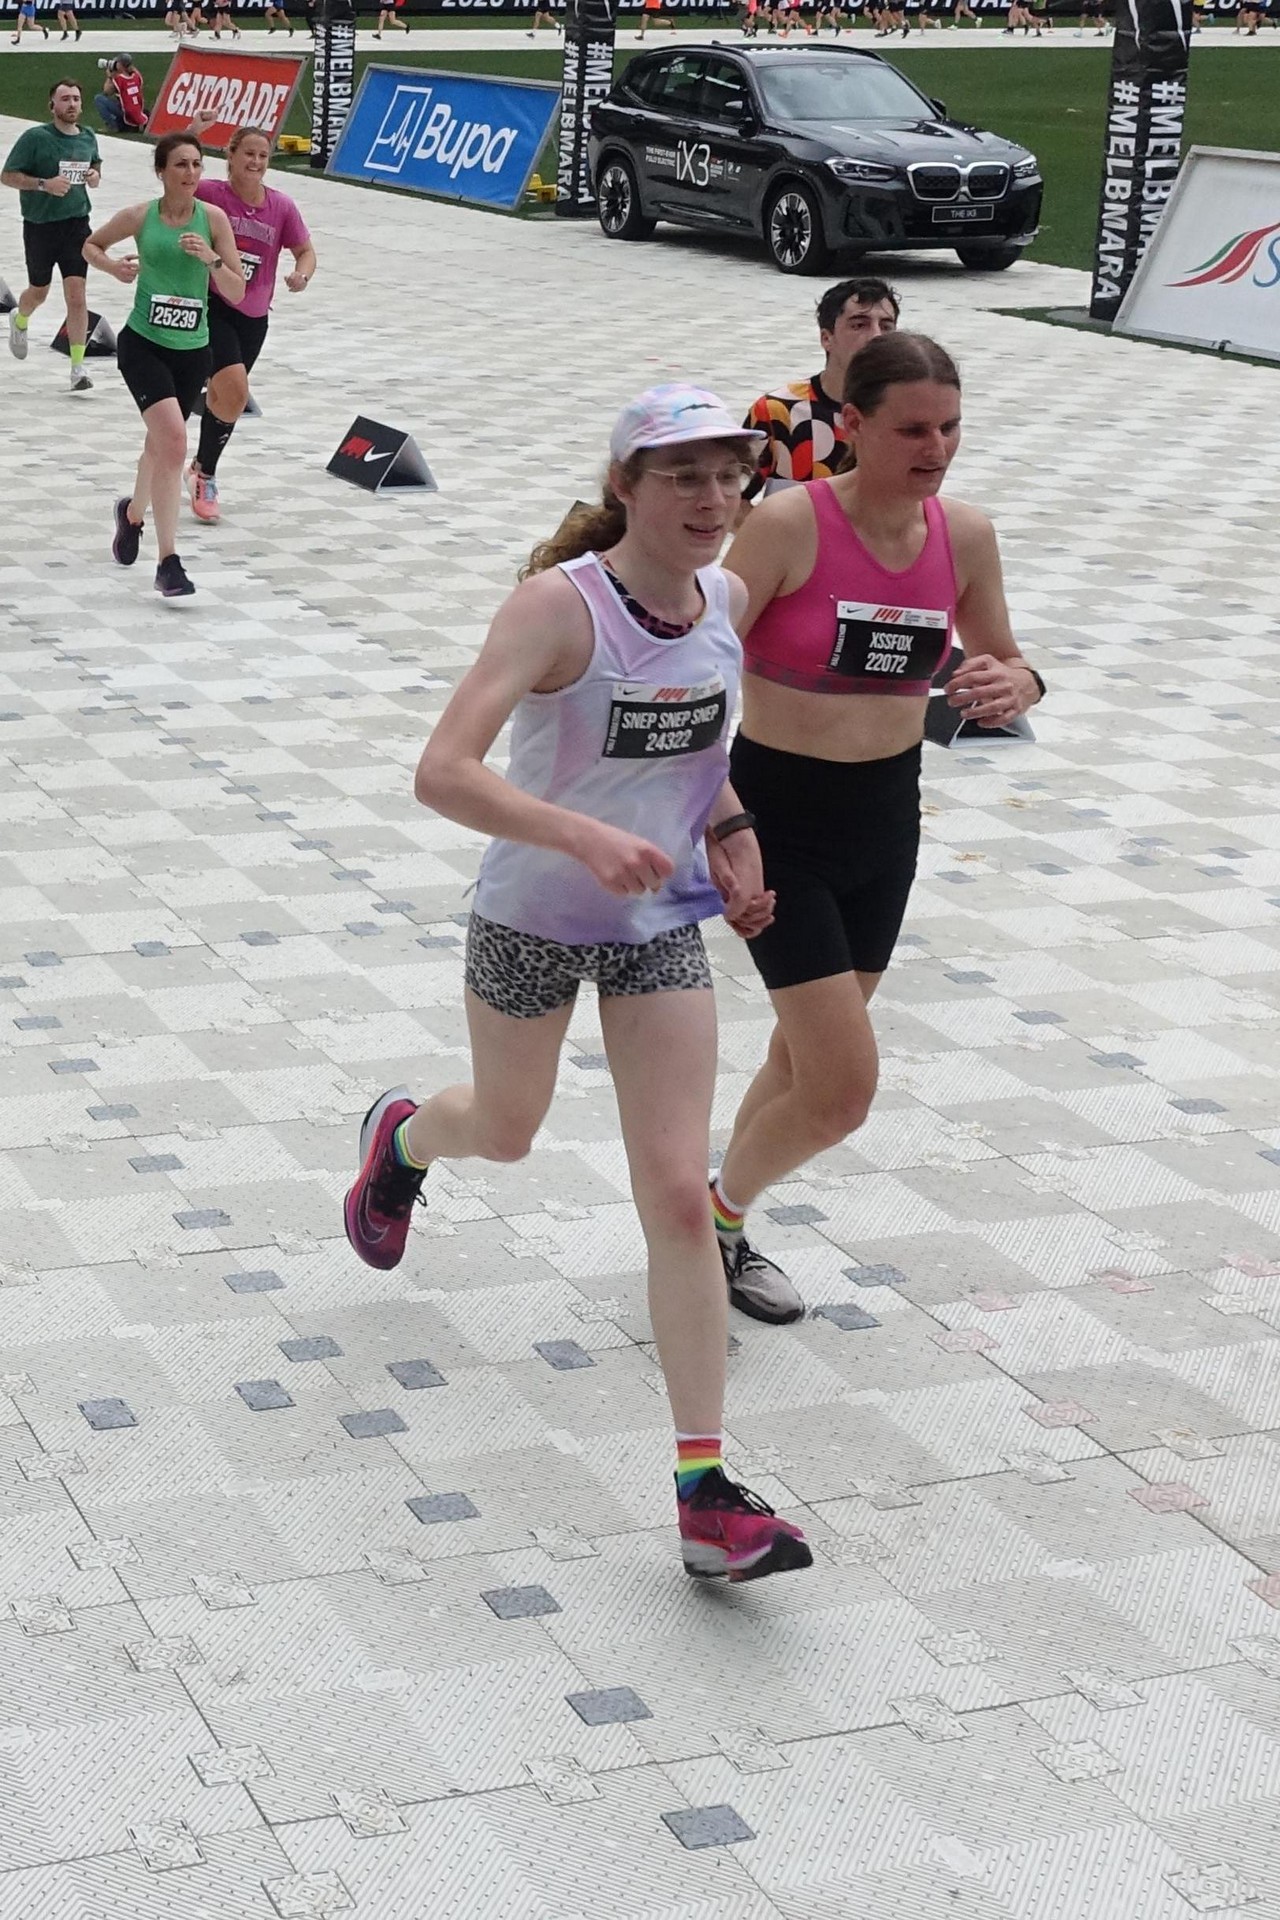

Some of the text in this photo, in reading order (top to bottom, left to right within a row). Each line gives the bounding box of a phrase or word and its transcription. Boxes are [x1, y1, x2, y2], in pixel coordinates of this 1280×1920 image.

[166, 72, 290, 132] GATORADE
[310, 24, 327, 156] #MELBMARA
[413, 103, 518, 179] Bupa
[557, 41, 580, 202] #MELBMARA
[676, 140, 711, 187] iX3
[1094, 80, 1140, 299] #MELBMARA
[153, 305, 198, 329] 25239
[864, 652, 908, 674] 22072
[868, 631, 915, 652] XSSFOX
[621, 703, 720, 730] SNEP SNEP SNEP
[644, 728, 693, 752] 24322
